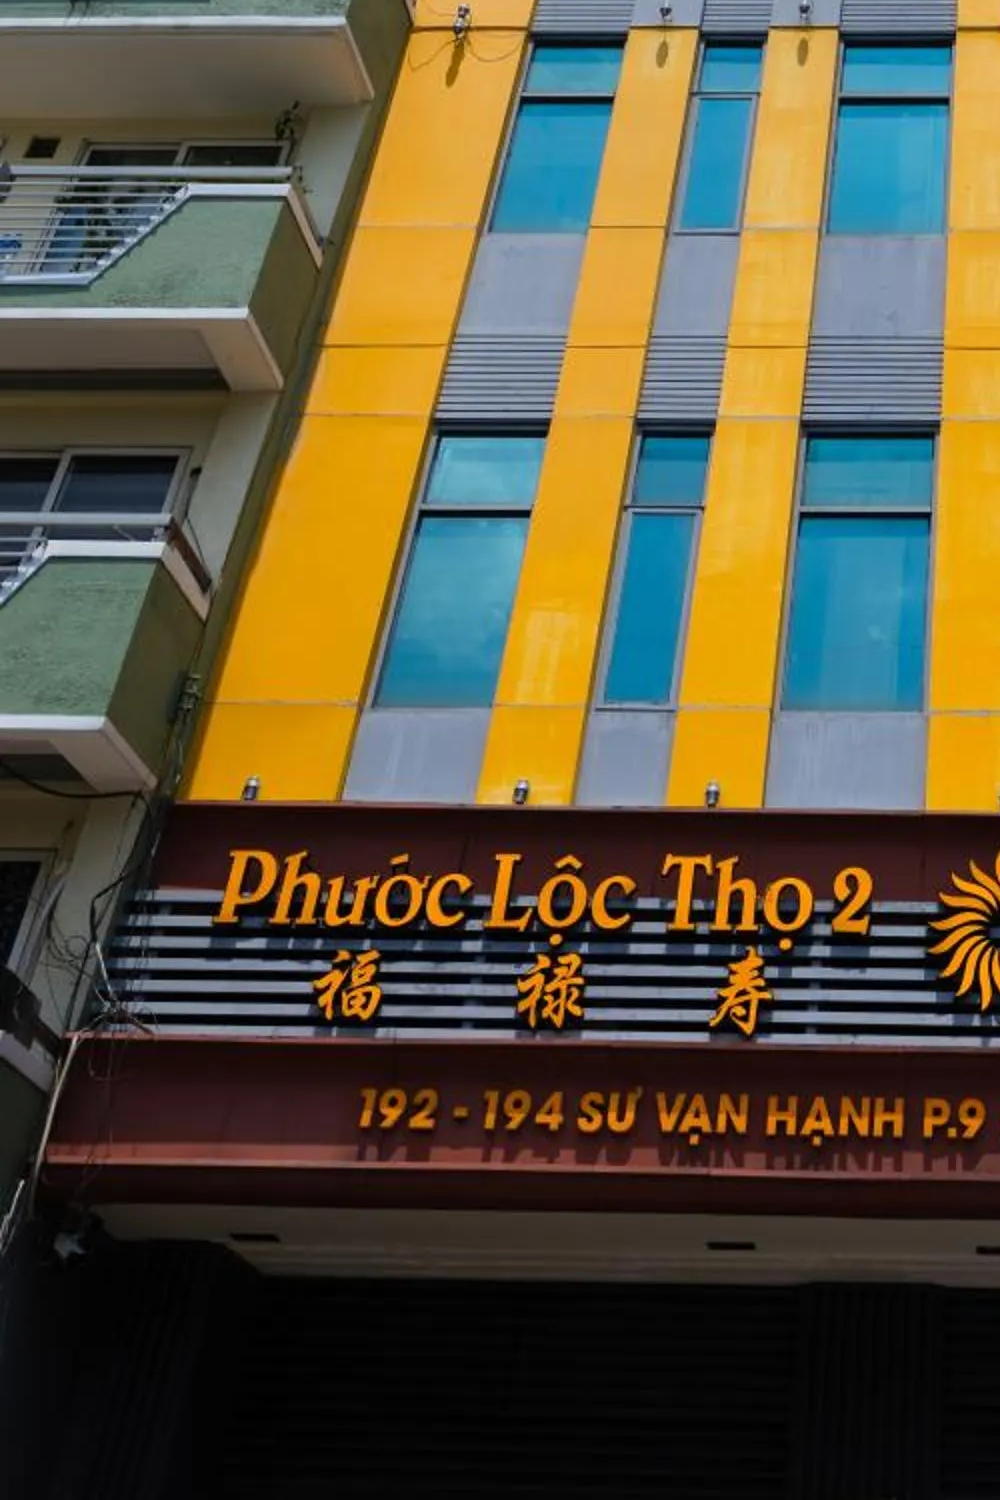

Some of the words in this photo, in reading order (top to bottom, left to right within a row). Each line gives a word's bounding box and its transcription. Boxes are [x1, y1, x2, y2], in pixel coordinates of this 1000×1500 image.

[212, 849, 475, 928] Phước
[482, 852, 637, 946] Lộc
[660, 852, 817, 951] Thọ
[830, 865, 874, 935] 2
[358, 1088, 438, 1129] 192
[483, 1089, 565, 1132] 194
[656, 1092, 749, 1146] VẠN
[764, 1095, 905, 1147] HẠNH
[922, 1097, 986, 1139] P.9
